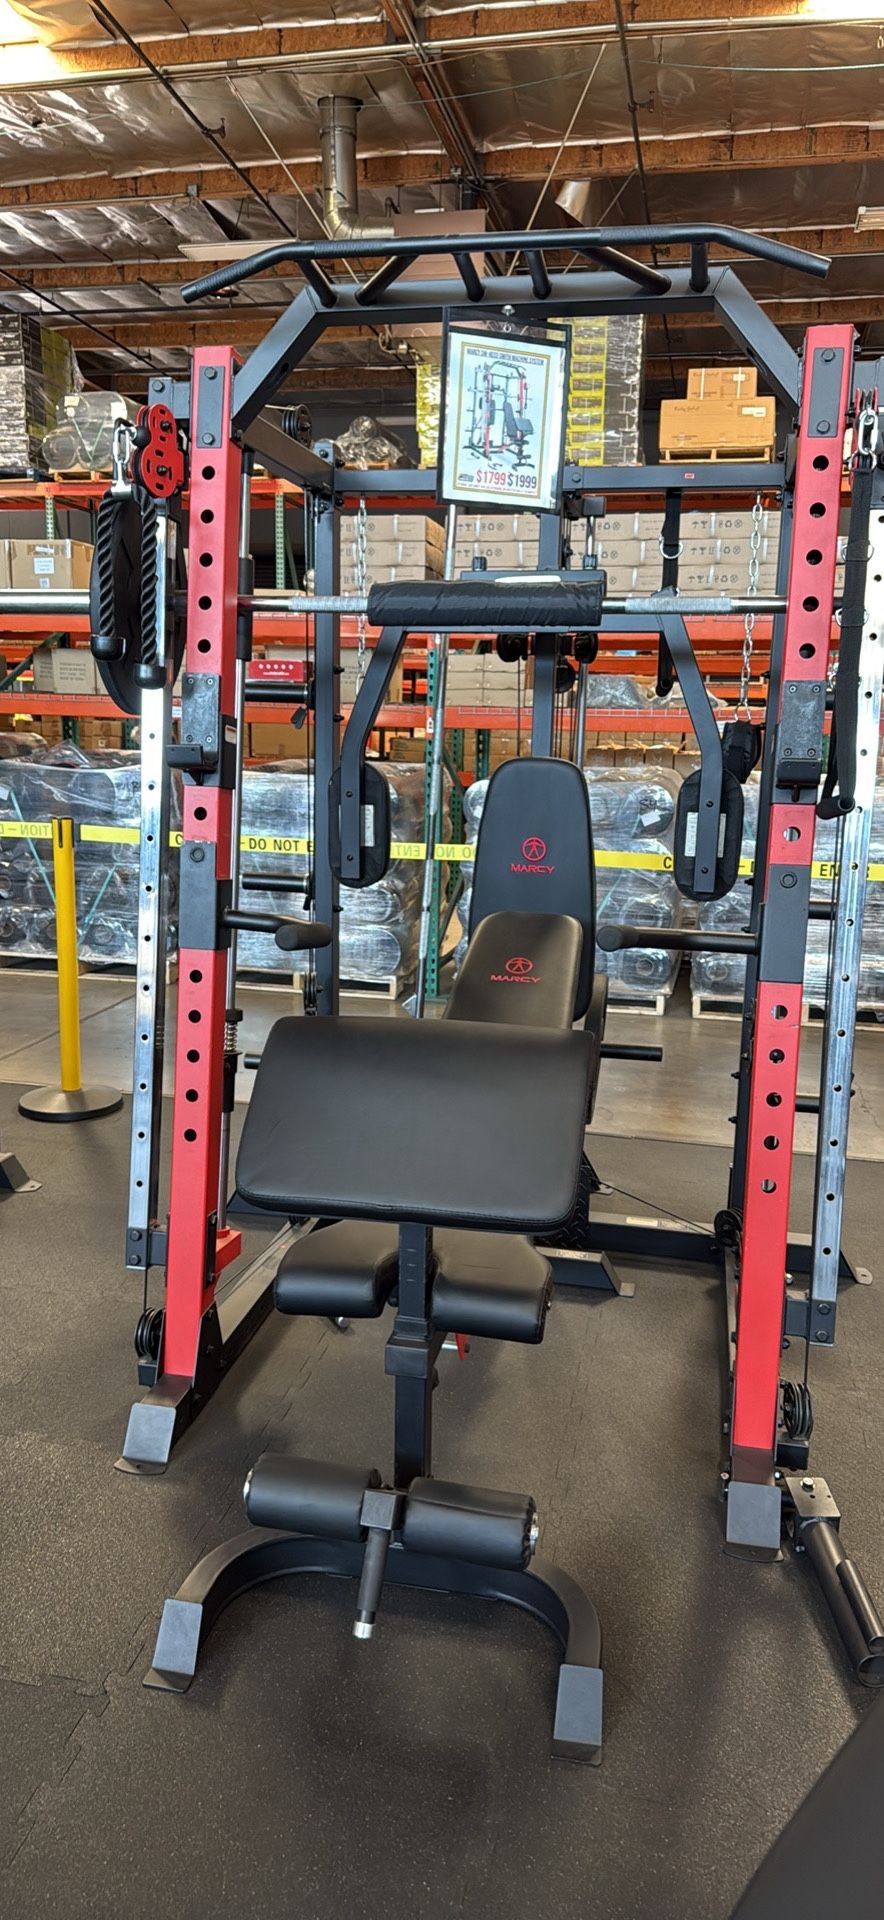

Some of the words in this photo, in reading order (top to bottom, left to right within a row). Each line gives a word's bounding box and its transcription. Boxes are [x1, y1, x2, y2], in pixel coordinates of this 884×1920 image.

[477, 470, 506, 486] $1799
[507, 472, 537, 489] $1999
[249, 838, 267, 850] DO
[273, 839, 300, 852] NOT
[510, 863, 555, 874] MARCY
[490, 974, 542, 983] MARCY
